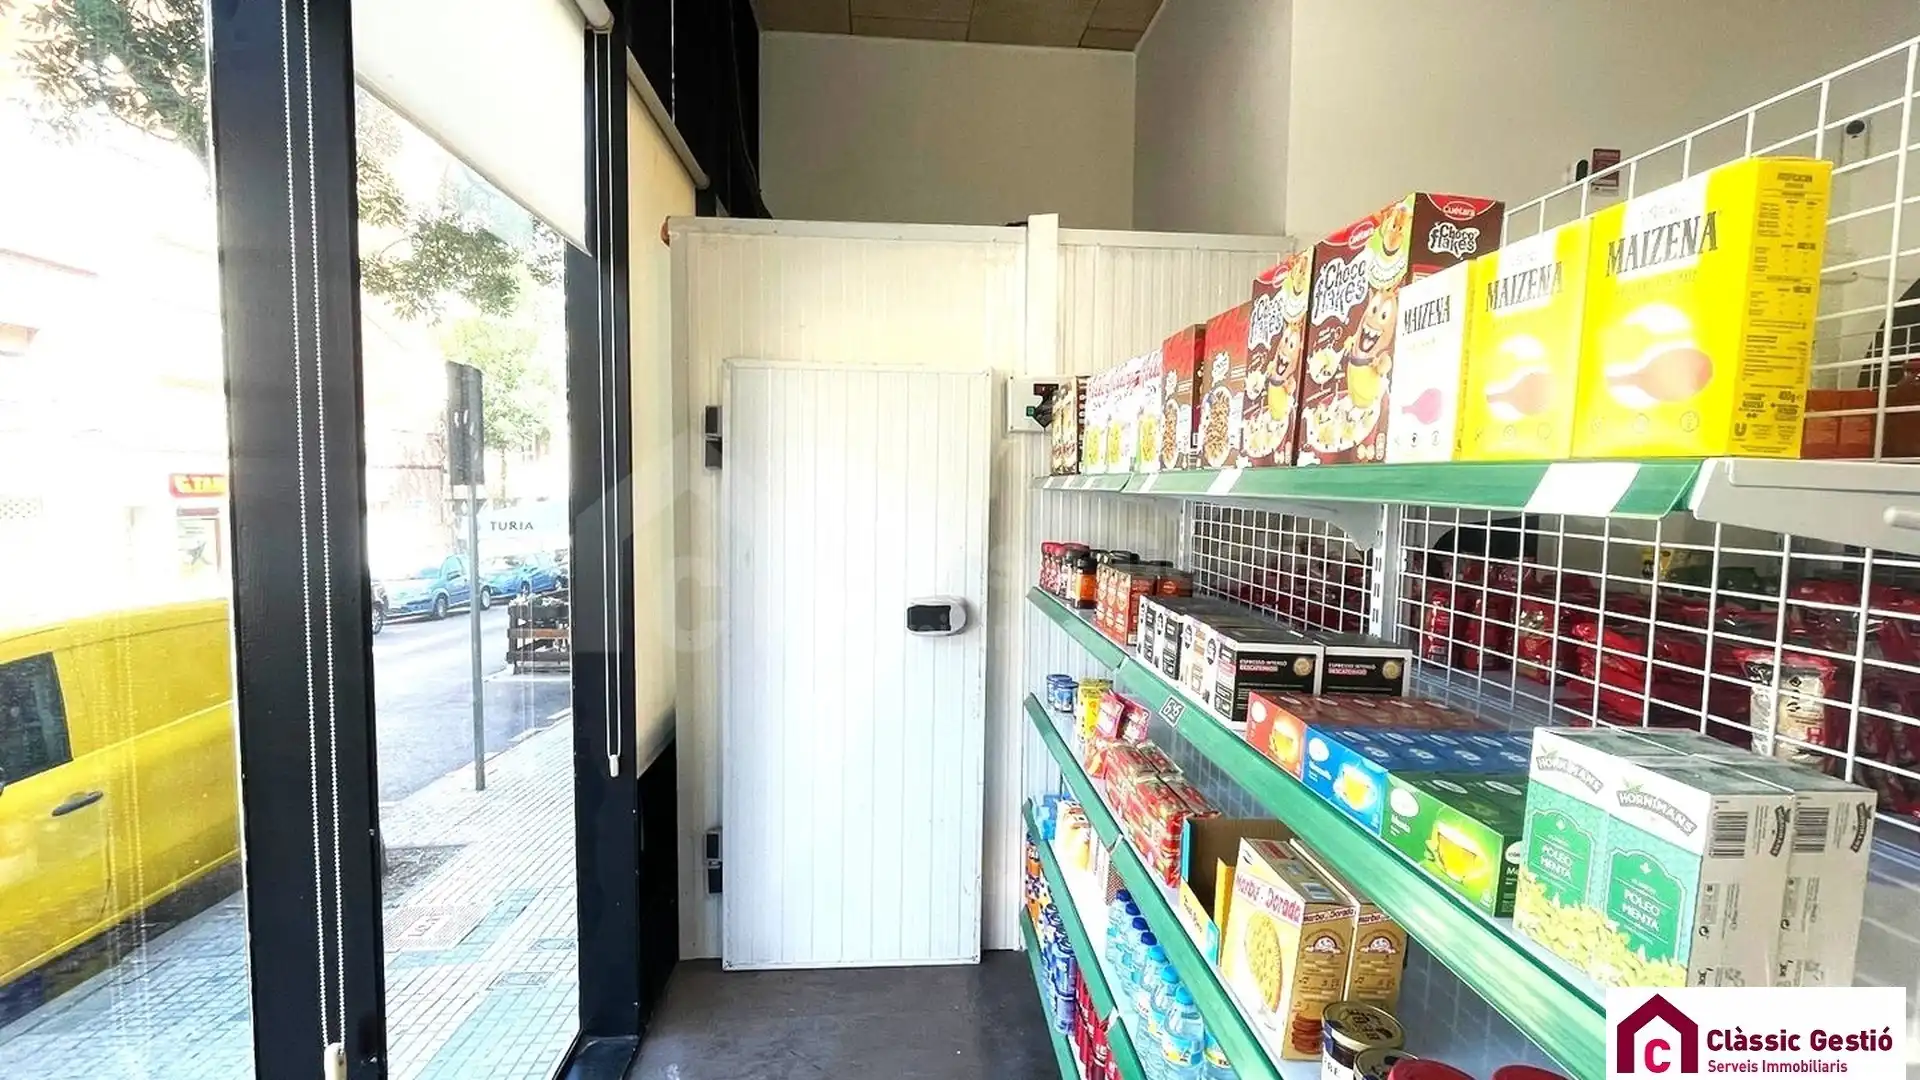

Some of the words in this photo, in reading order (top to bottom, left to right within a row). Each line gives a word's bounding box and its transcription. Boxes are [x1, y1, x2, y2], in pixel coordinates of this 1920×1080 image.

[1439, 224, 1474, 241] Choco
[1605, 210, 1718, 278] MAIZENA
[1324, 260, 1366, 290] Choco
[1485, 260, 1563, 312] MAIZENA
[1402, 295, 1451, 336] MAIZENA
[490, 521, 534, 531] TURIA
[1622, 904, 1660, 932] MENTA
